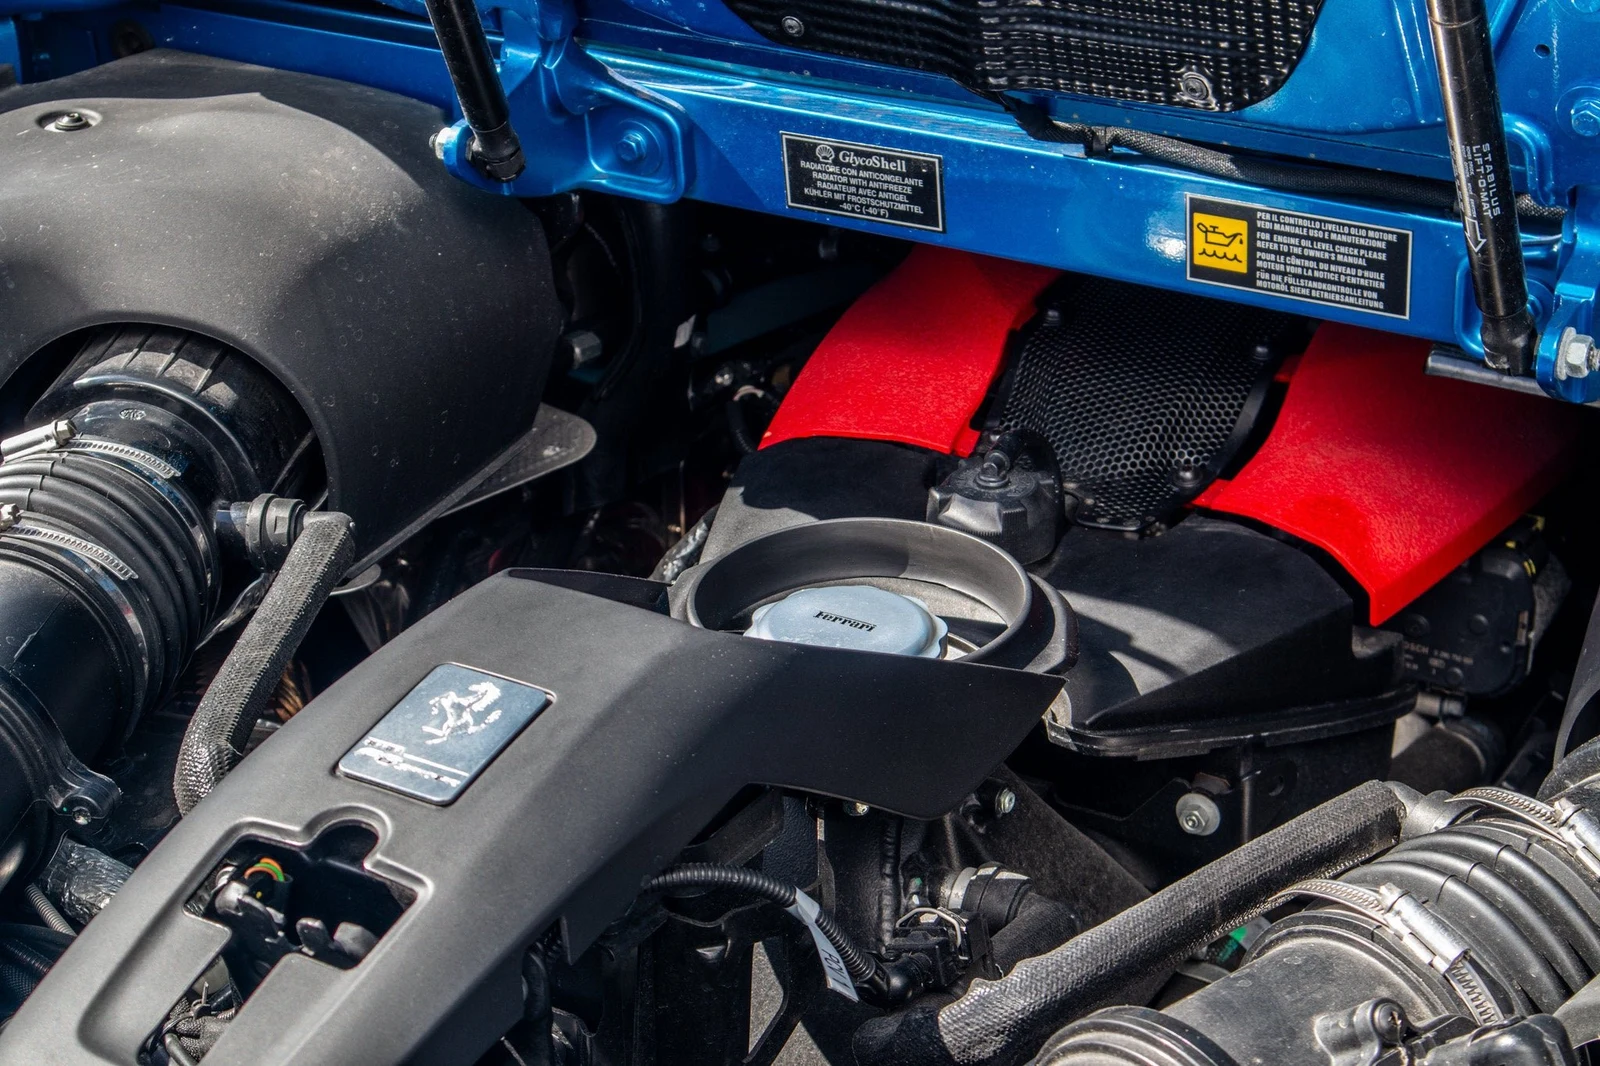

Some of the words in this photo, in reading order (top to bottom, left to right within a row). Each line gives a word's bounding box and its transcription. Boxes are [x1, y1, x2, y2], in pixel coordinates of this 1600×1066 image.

[800, 160, 840, 174] RADIATORE
[842, 167, 858, 176] CON
[858, 170, 923, 187] ANTICONGELANTE
[839, 150, 907, 172] GlycoShell
[812, 171, 848, 184] RADIATOR
[849, 177, 867, 187] WITH
[869, 180, 913, 194] ANTIFREEZE
[817, 181, 857, 194] RADIATEUR
[858, 188, 877, 197] AVEC
[878, 191, 909, 203] ANTIGEL
[1482, 143, 1501, 217] STABILUS
[804, 187, 832, 198] KÜHLER
[834, 192, 846, 201] MIT
[847, 194, 923, 214] FROSTSCHUTZMITTEL
[1257, 211, 1270, 220] PER
[1280, 215, 1320, 229] CONTROLLO
[1321, 222, 1349, 234] LIVELLO
[1350, 227, 1366, 237] OLIO
[1368, 230, 1397, 242] MOTORE
[1257, 220, 1272, 230] VEDI
[1274, 223, 1308, 236] MANUALE
[1309, 229, 1323, 238] USO
[1330, 233, 1387, 249] MANUTENZIONE
[1257, 231, 1270, 240] FOR
[1274, 234, 1300, 246] ENGINE
[1301, 239, 1312, 248] OIL
[1314, 241, 1334, 251] LEVEL
[1335, 245, 1359, 256] CHECK
[1360, 249, 1387, 261] PLEASE
[1257, 240, 1278, 250] REFER
[1280, 244, 1288, 252] TO
[1290, 246, 1302, 255] THE
[1337, 254, 1367, 266] MANUAL
[1257, 251, 1276, 261] POUR
[1276, 255, 1285, 263] LE
[1319, 262, 1329, 271] DU
[1330, 264, 1356, 276] NIVEAU
[1257, 260, 1284, 272] MOTEUR
[1286, 265, 1302, 275] VOIR
[1304, 268, 1312, 276] LA
[1314, 270, 1339, 281] NOTICE
[1256, 280, 1289, 292] MOTORÖL
[1290, 285, 1310, 296] SIEHE
[1257, 269, 1270, 280] FÜR
[1271, 274, 1283, 282] DIE
[1363, 290, 1378, 299] VON
[813, 610, 877, 632] Ferrari
